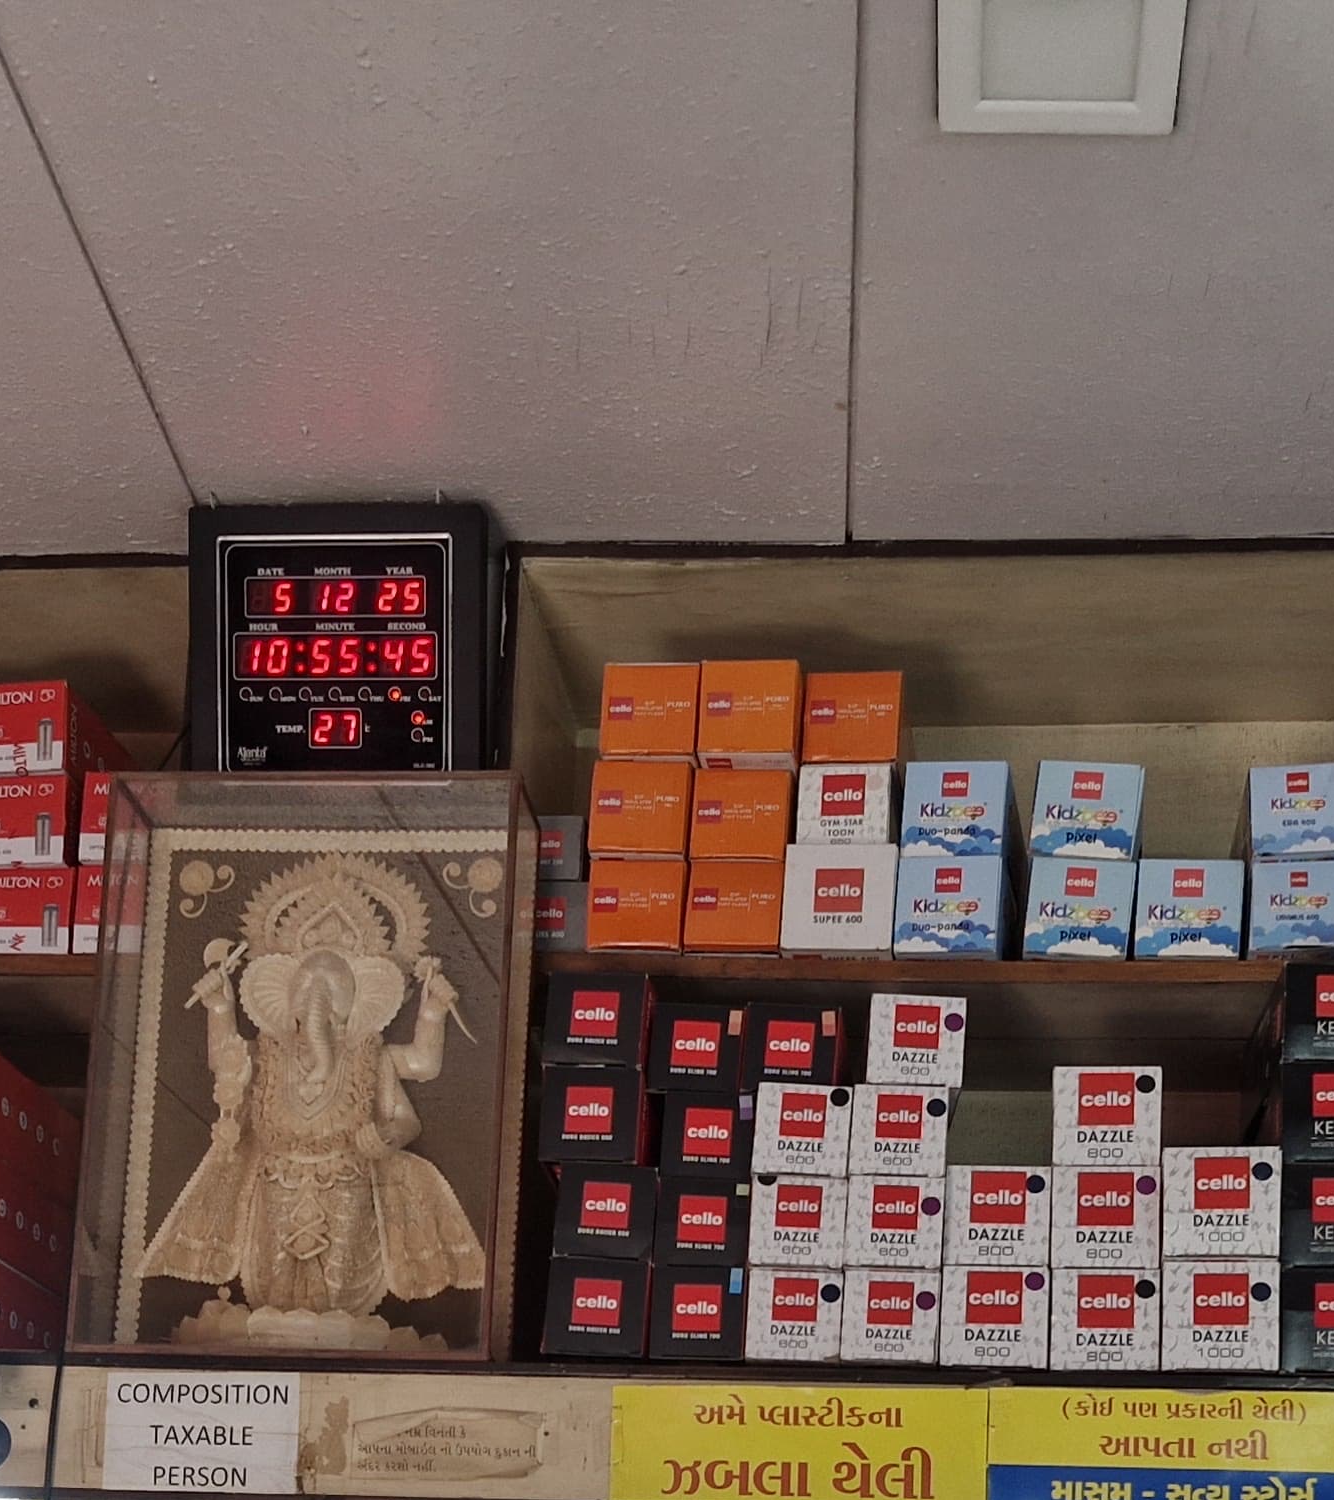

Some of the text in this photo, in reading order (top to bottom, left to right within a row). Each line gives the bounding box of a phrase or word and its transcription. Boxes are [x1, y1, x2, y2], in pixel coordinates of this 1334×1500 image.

[257, 567, 413, 576] DATE MONTH YEAR
[274, 582, 420, 612] 5 12 25
[249, 623, 426, 631] HOUR MINUTE SECOND
[609, 704, 632, 714] cello
[314, 715, 356, 744] 27
[943, 780, 967, 789] cello
[1074, 780, 1101, 792] cello
[823, 789, 863, 801] cello
[1174, 878, 1203, 889] cello
[817, 884, 861, 897] cello
[813, 914, 862, 924] SUPEE 600
[574, 1008, 615, 1021] cello
[896, 1021, 937, 1034] cello
[674, 1038, 716, 1052] cello
[892, 1052, 938, 1064] DAZZLE
[1080, 1092, 1132, 1106] cello
[1077, 1130, 1134, 1143] DAZZLE
[1087, 1148, 1123, 1158] 800
[1196, 1176, 1247, 1190] cello
[1193, 1214, 1250, 1227] DAZZLE
[117, 1383, 289, 1405] COMPOSITION
[694, 1394, 747, 1426] અમે
[1123, 1402, 1157, 1418] પણ
[1167, 1396, 1243, 1420] પ્રકારની
[150, 1424, 253, 1446] TAXABLE
[1098, 1430, 1268, 1461] આપતા નથી
[153, 1466, 247, 1487] PERSON
[661, 1442, 935, 1499] ઝબલા થેલી
